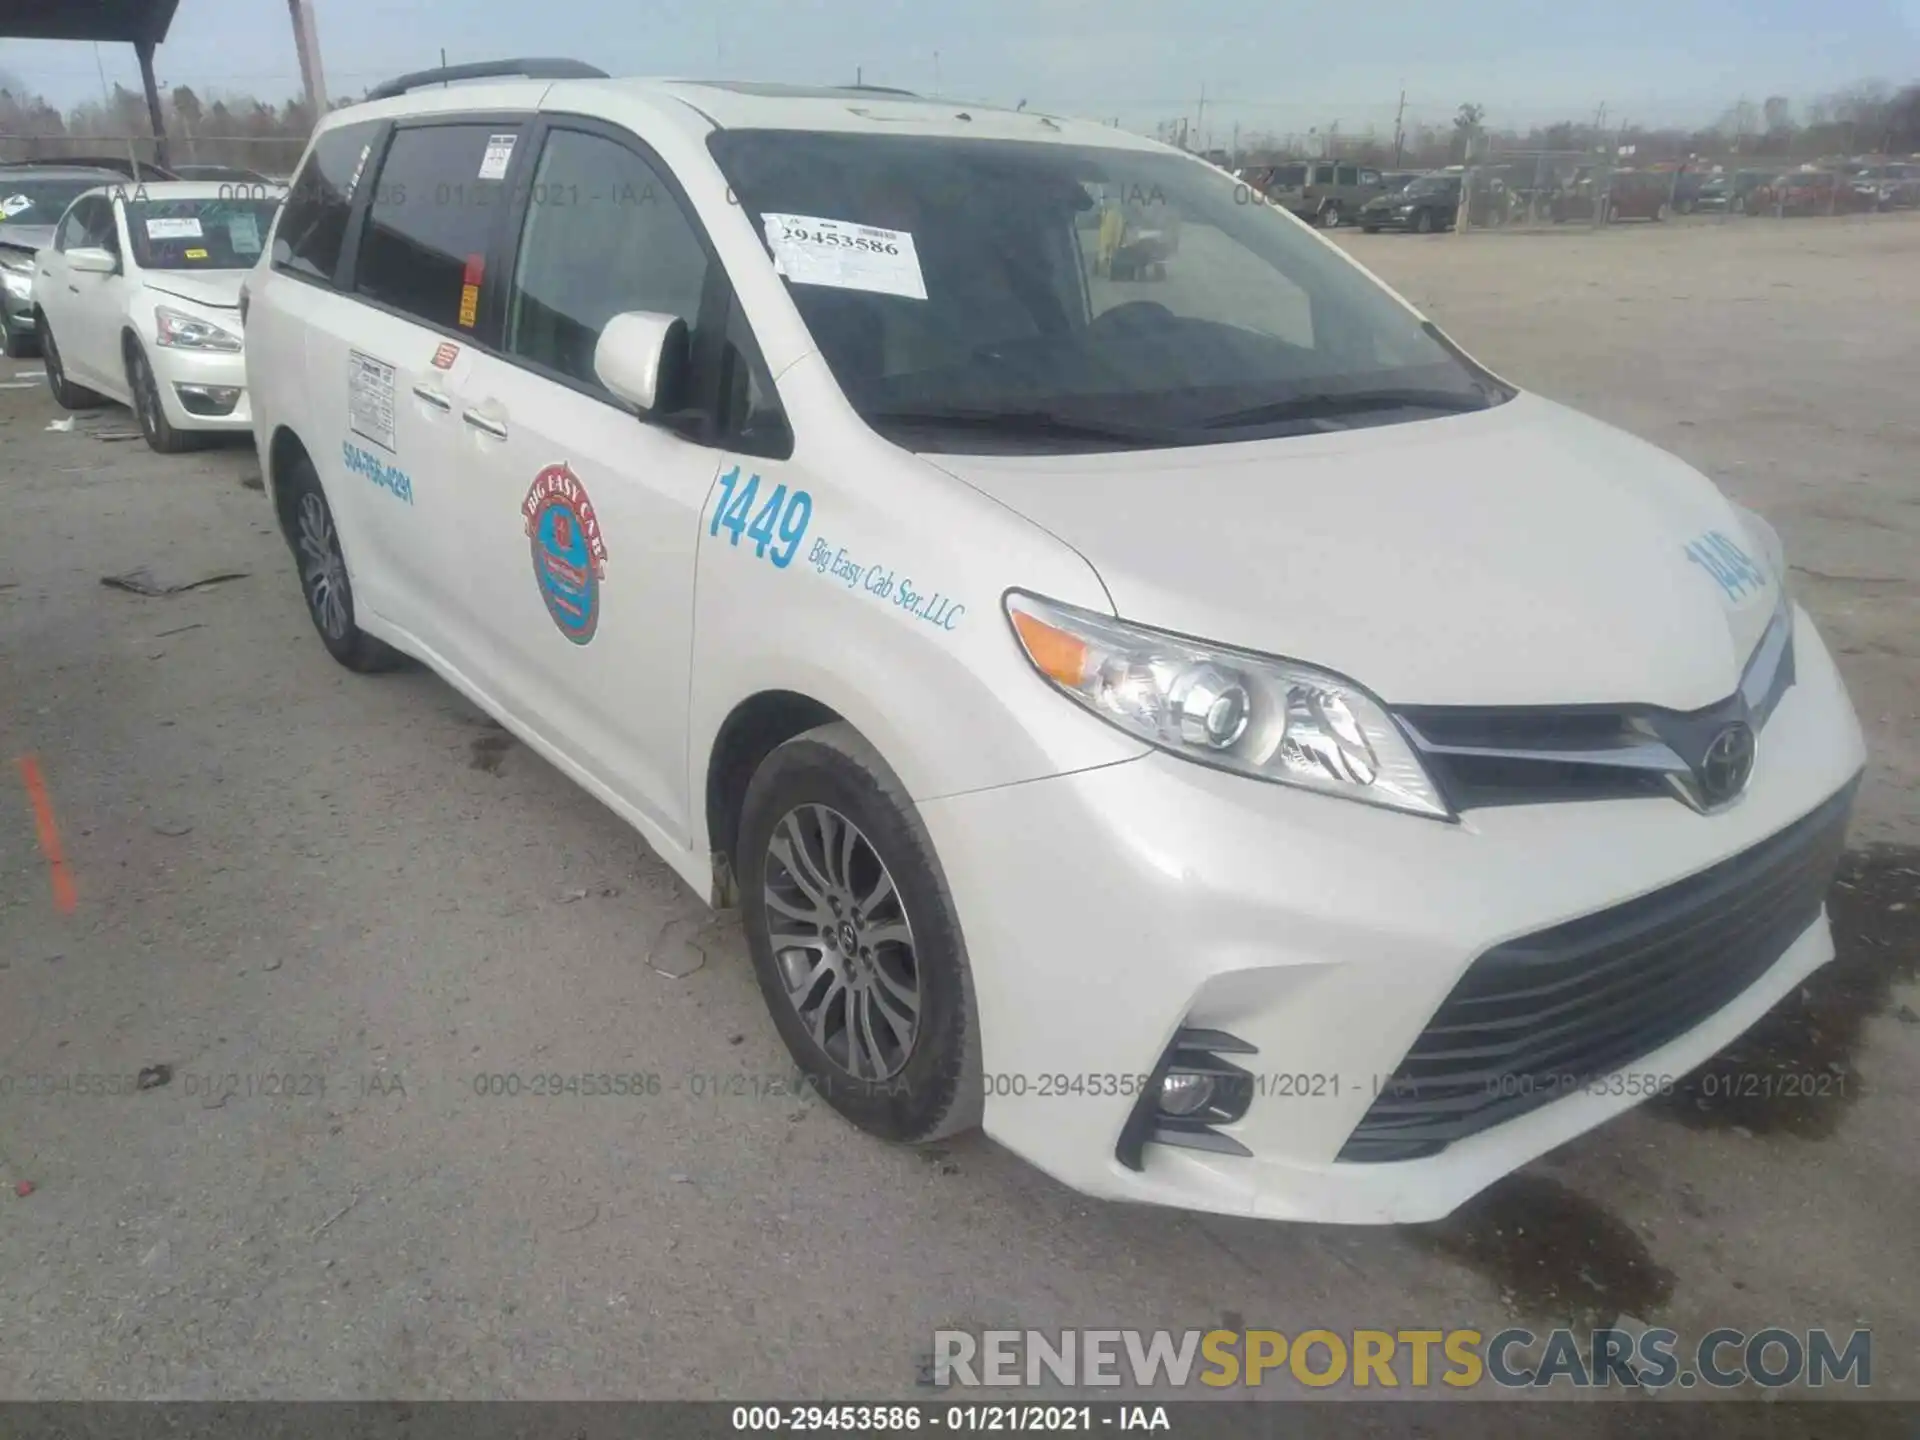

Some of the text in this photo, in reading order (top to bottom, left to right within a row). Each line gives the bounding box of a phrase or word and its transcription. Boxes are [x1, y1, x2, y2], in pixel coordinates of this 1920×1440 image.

[783, 225, 899, 256] 29453586
[548, 474, 580, 504] EASY
[710, 465, 813, 568] 1449
[807, 536, 833, 574] Big
[831, 548, 864, 588] Easy
[864, 564, 894, 598] Cab
